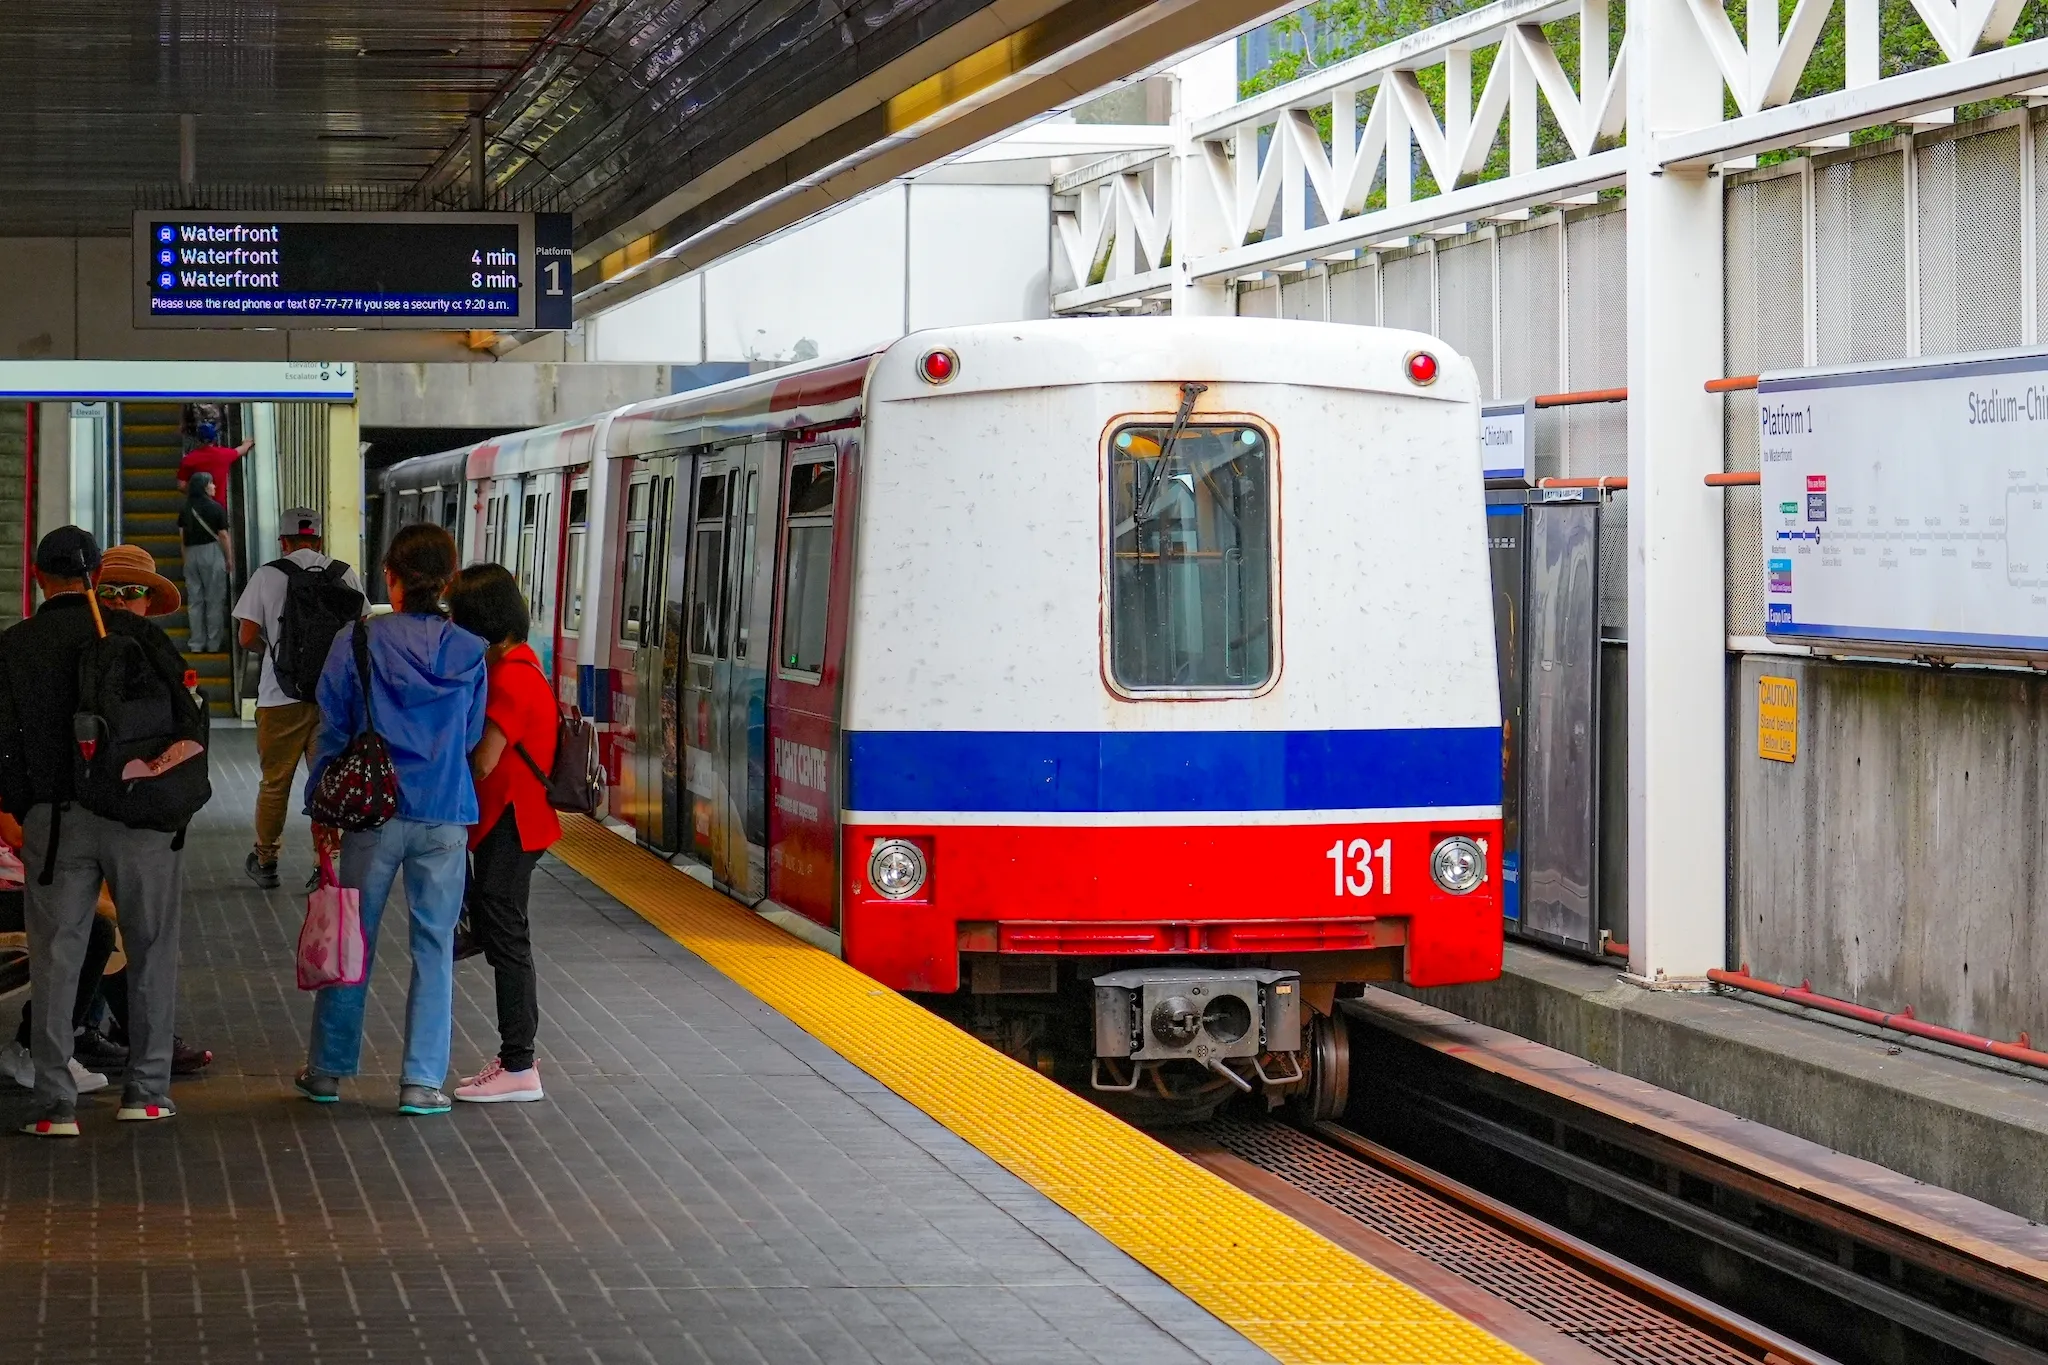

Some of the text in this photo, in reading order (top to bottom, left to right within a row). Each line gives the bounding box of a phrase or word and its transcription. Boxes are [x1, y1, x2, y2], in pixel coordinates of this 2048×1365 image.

[181, 225, 279, 242] Waterfront
[181, 248, 516, 265] Waterfront 4 min
[536, 247, 572, 256] Platform
[181, 270, 516, 288] Waterfront 8 min
[544, 261, 564, 296] 1
[152, 298, 183, 309] Please
[186, 300, 203, 309] use
[205, 298, 221, 309] the
[223, 298, 240, 309] red
[242, 298, 272, 312] phone
[274, 300, 285, 309] or
[288, 299, 307, 309] text
[309, 299, 354, 309] 87-77-77
[355, 299, 363, 309] if
[364, 300, 382, 312] you
[384, 300, 400, 309] see
[403, 300, 410, 309] a
[411, 299, 450, 312] security
[465, 299, 486, 309] 9:20
[285, 372, 318, 380] Escalator
[1762, 404, 1813, 436] Platform 1
[1769, 608, 1792, 627] Expo Line
[1761, 683, 1795, 708] CAUTION
[1760, 713, 1795, 732] Stand behind
[1763, 733, 1792, 752] Yellow Line
[774, 736, 827, 793] FLIGHT CENTRE
[1326, 838, 1391, 897] 131
